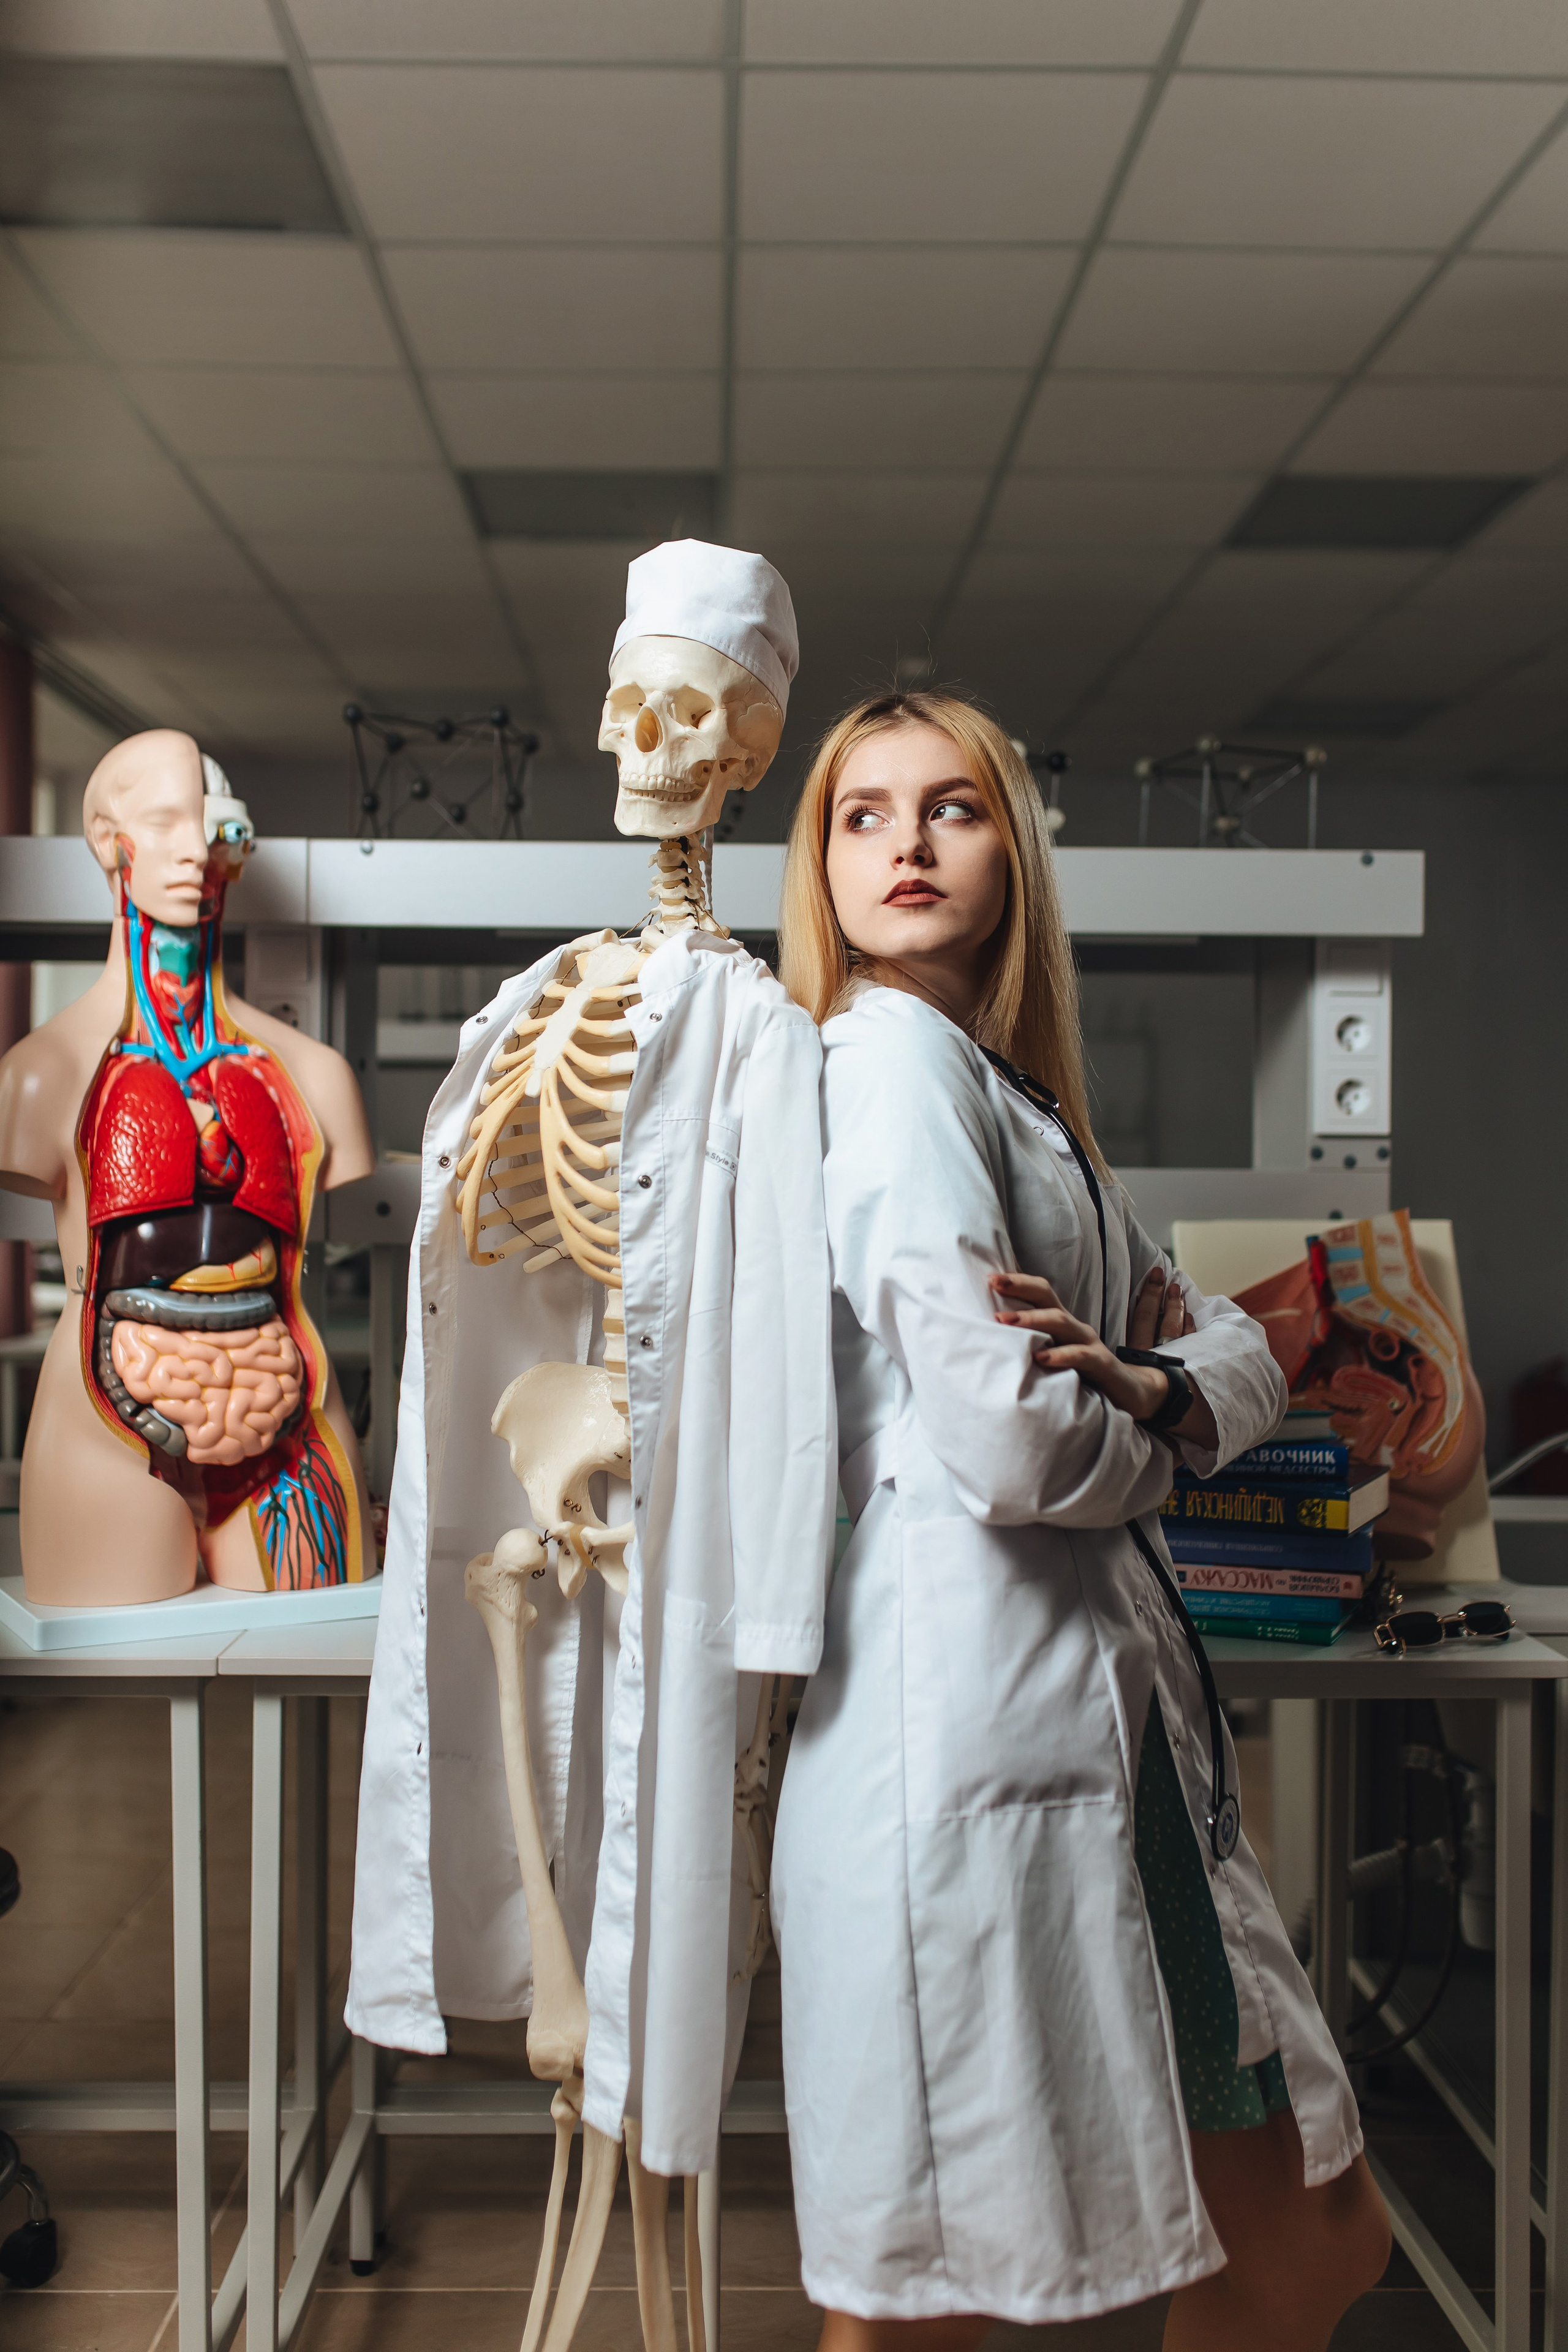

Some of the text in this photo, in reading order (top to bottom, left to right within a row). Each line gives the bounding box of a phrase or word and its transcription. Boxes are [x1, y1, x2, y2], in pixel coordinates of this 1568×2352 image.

[710, 1153, 729, 1165] Style
[1270, 1464, 1336, 1475] МЕДСЕСТРЫ
[1186, 1488, 1285, 1524] МЕДИЦИНСКАЯ
[1189, 1569, 1273, 1590] МАССАЖУ
